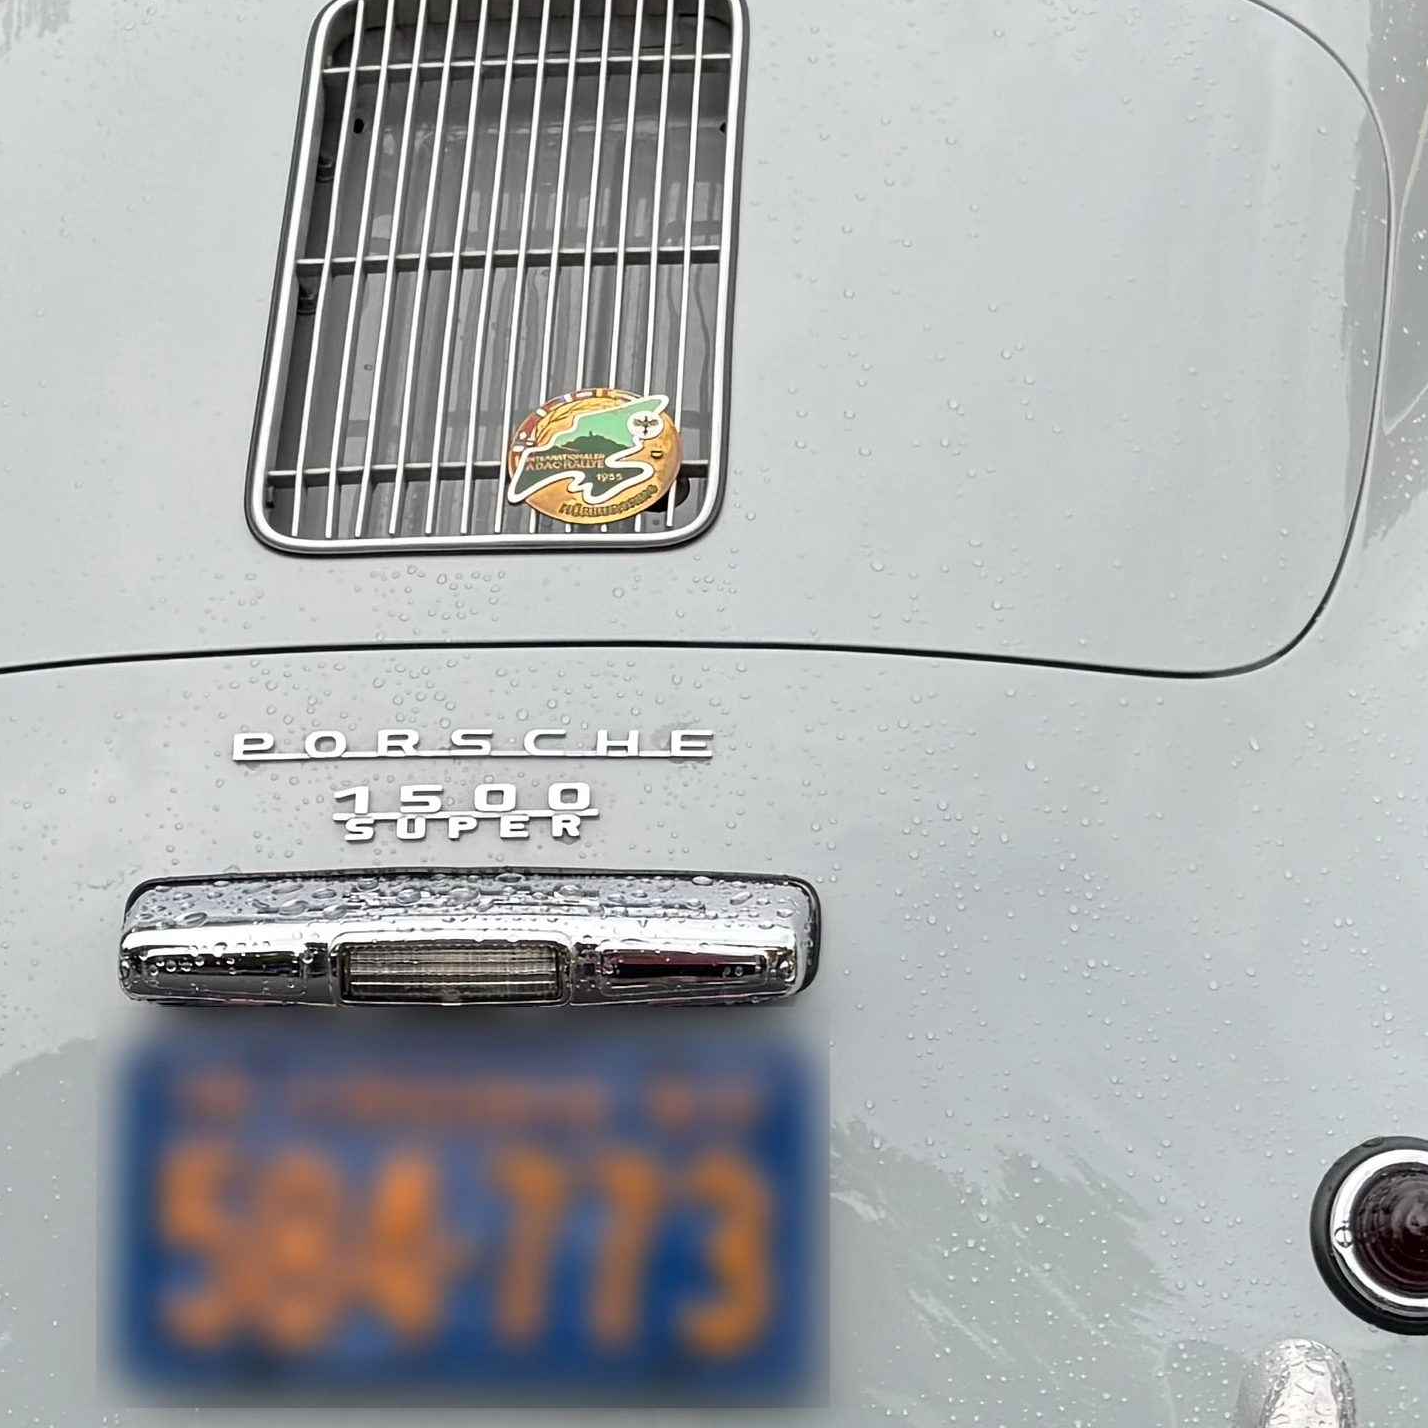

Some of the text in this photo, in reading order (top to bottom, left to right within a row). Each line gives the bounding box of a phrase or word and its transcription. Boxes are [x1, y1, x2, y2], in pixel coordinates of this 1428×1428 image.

[231, 728, 714, 761] PORSCHE
[333, 781, 594, 815] 1500
[344, 814, 582, 841] SUPER
